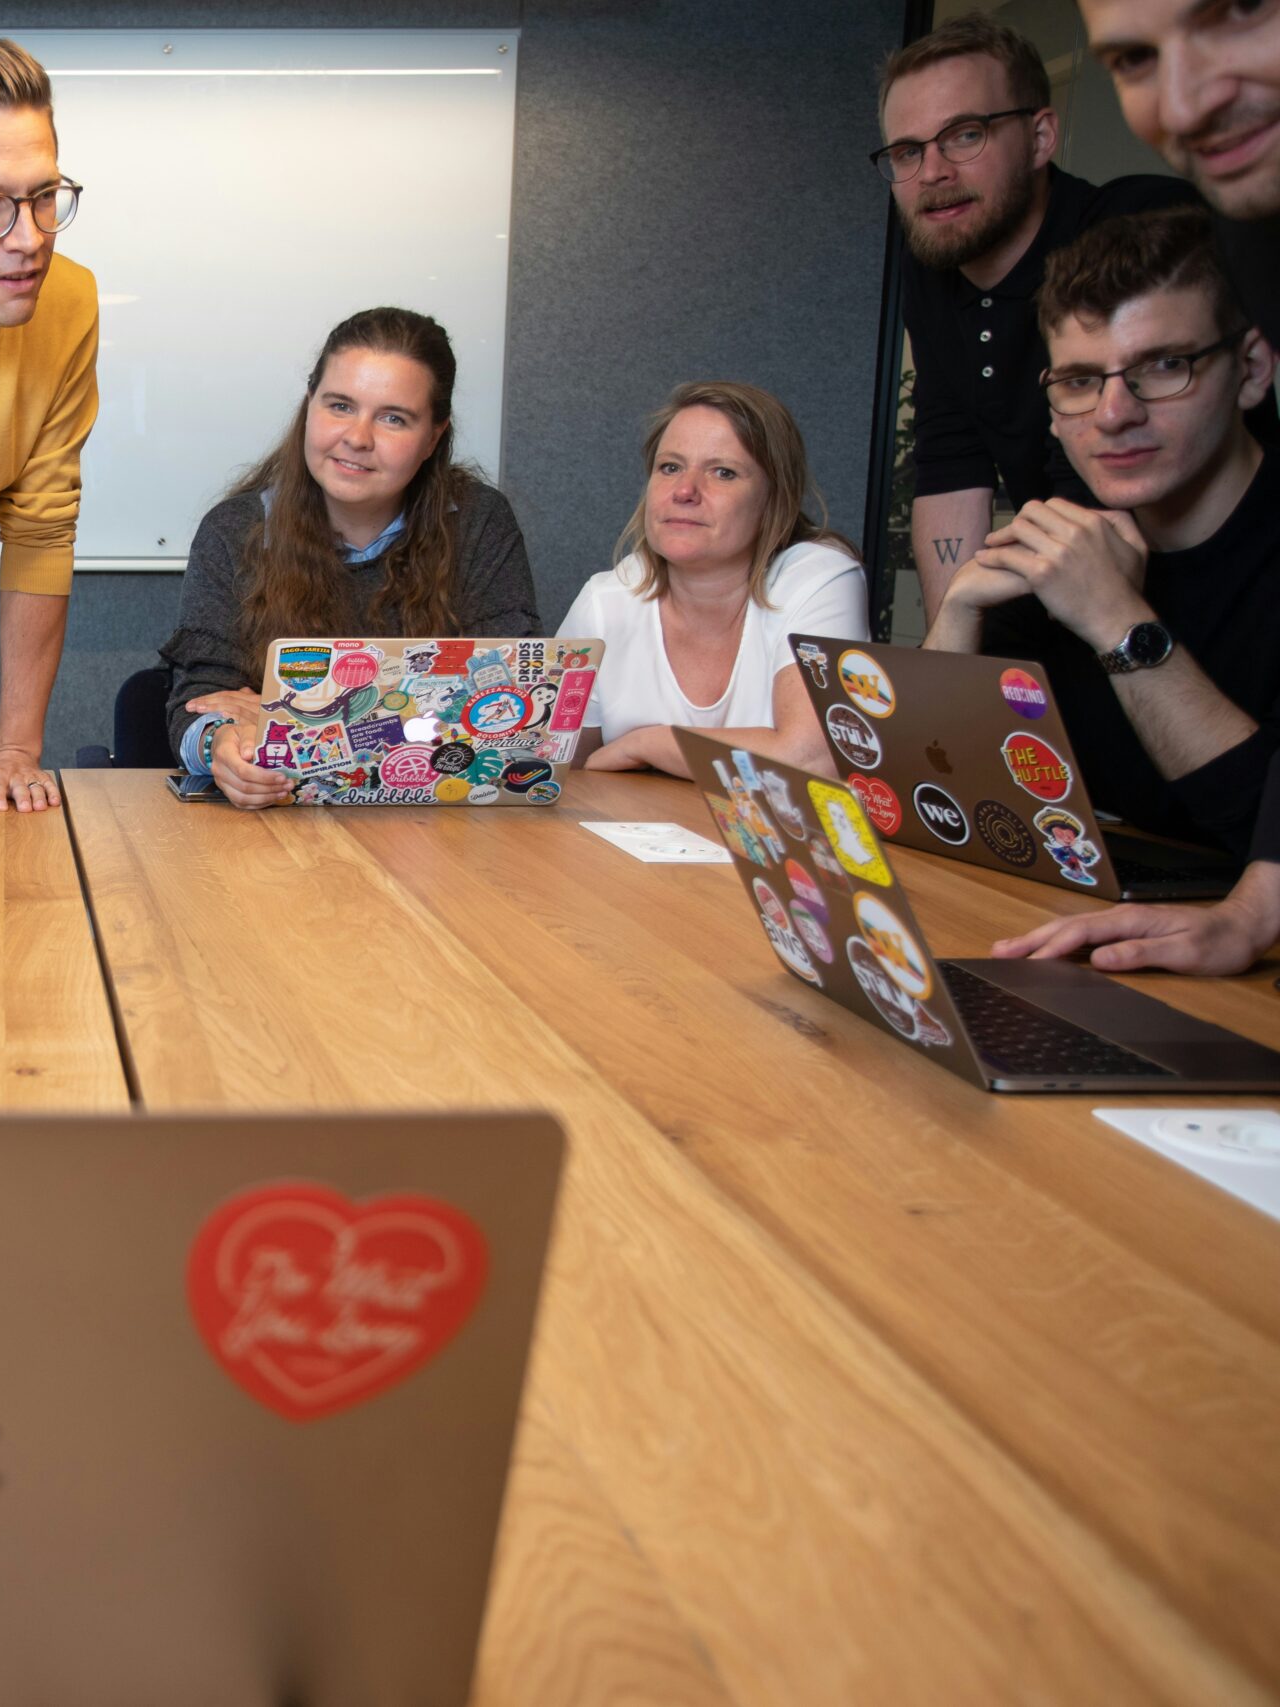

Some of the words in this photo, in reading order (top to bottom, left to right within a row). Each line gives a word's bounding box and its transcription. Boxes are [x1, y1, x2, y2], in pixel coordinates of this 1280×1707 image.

[932, 538, 963, 564] W
[519, 642, 530, 682] DROIDS
[848, 674, 879, 700] W
[477, 729, 515, 738] DOLOMITI
[1004, 747, 1039, 765] THE
[302, 760, 352, 776] INSPIRATION
[1016, 765, 1069, 782] HUSTLE
[341, 788, 437, 804] dribbble
